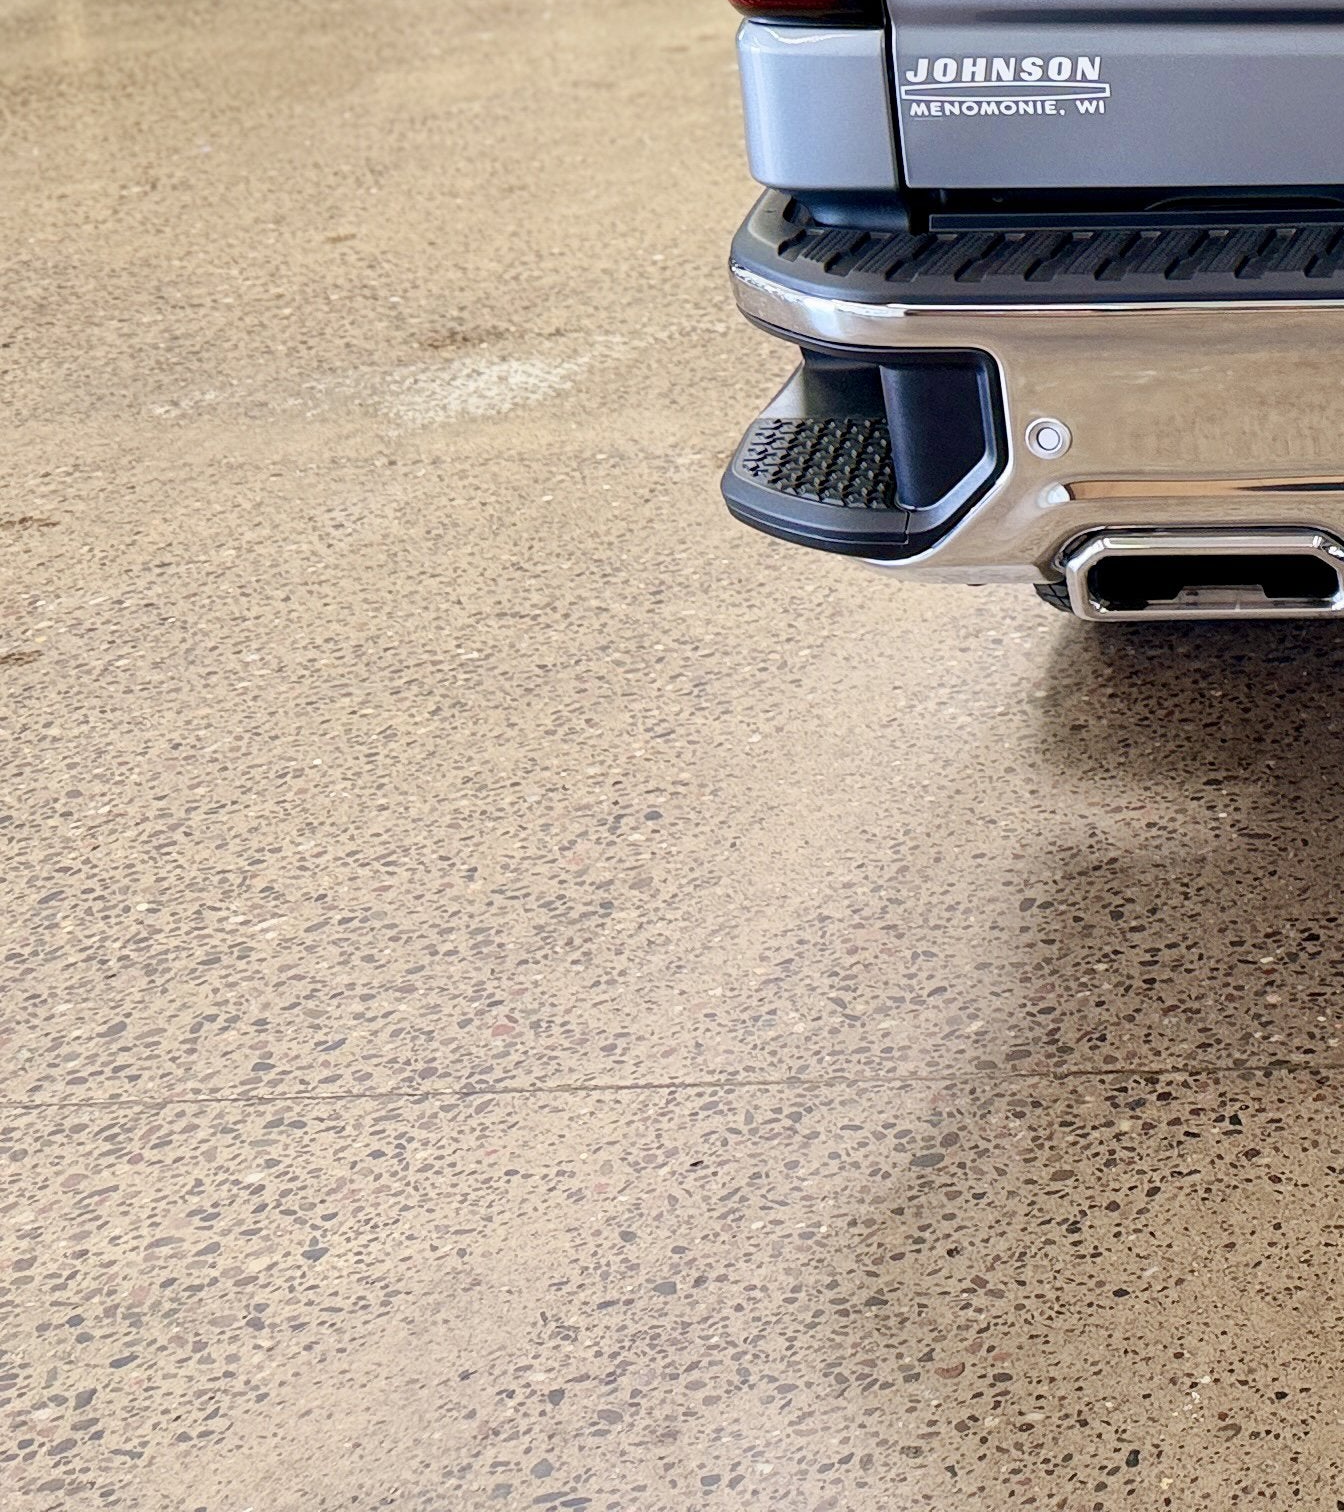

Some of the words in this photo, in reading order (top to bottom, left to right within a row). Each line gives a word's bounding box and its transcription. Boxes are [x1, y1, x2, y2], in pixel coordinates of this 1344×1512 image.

[905, 56, 1101, 83] JOHNSON
[909, 100, 1066, 116] MENOMONIE,
[1075, 99, 1106, 115] WI
